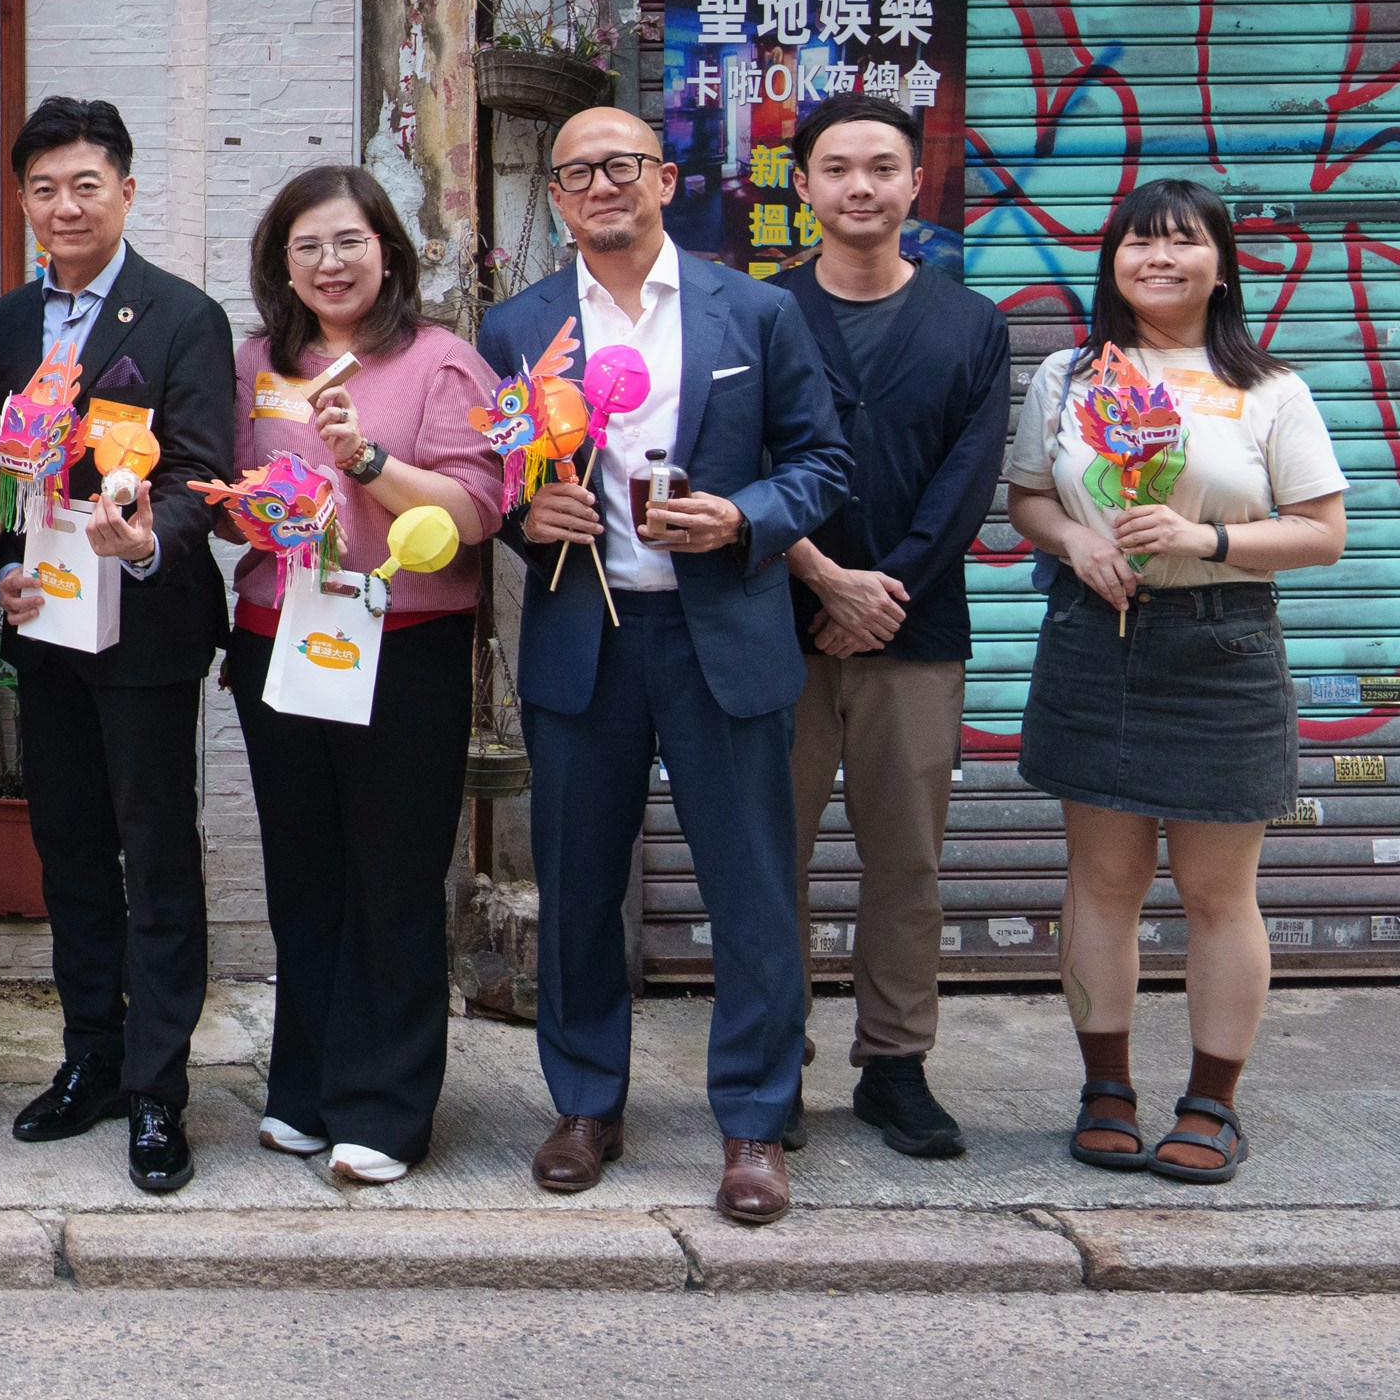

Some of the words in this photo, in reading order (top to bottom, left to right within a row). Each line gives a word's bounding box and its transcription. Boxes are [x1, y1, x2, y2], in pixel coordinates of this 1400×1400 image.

[686, 59, 942, 107] 卡啦OK夜總會
[1340, 762, 1360, 776] 5513
[1361, 762, 1380, 776] 1221
[1269, 932, 1310, 943] 69111711
